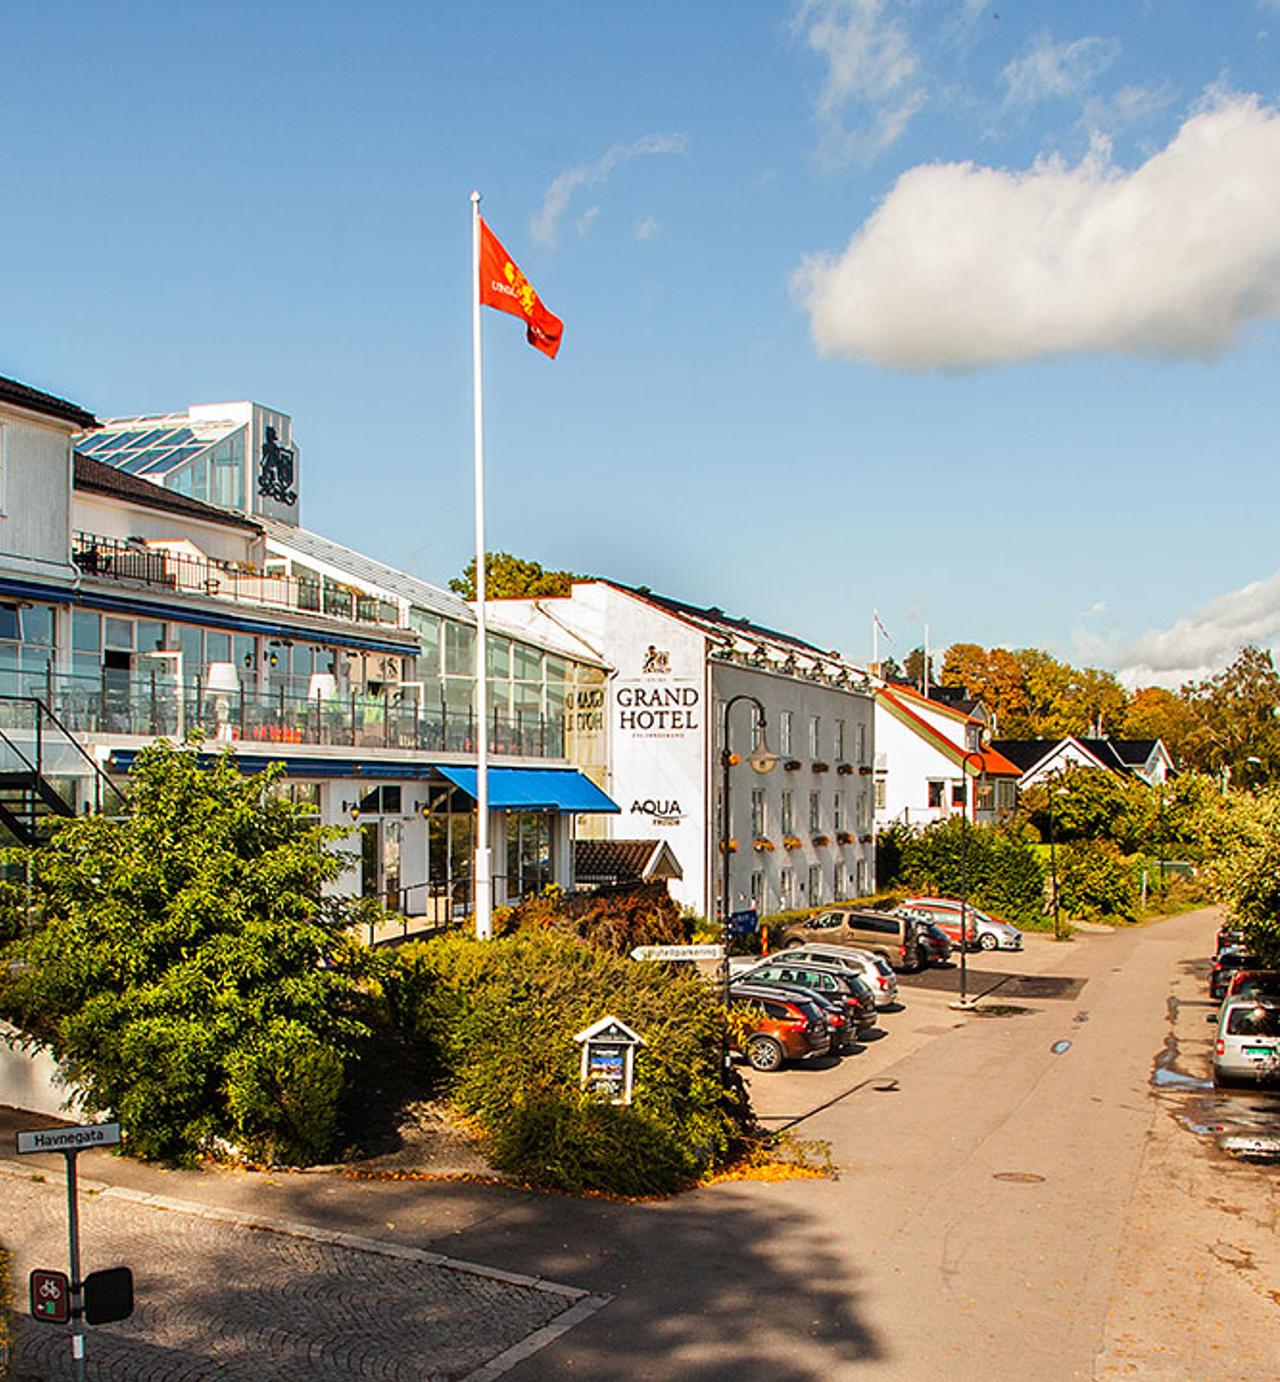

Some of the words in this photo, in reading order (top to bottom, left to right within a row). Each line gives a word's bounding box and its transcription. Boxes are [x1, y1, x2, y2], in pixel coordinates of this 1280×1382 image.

[616, 688, 699, 707] GRAND
[620, 711, 699, 730] HOTEL
[630, 799, 682, 818] AQUA
[34, 1130, 104, 1147] Havnegata
